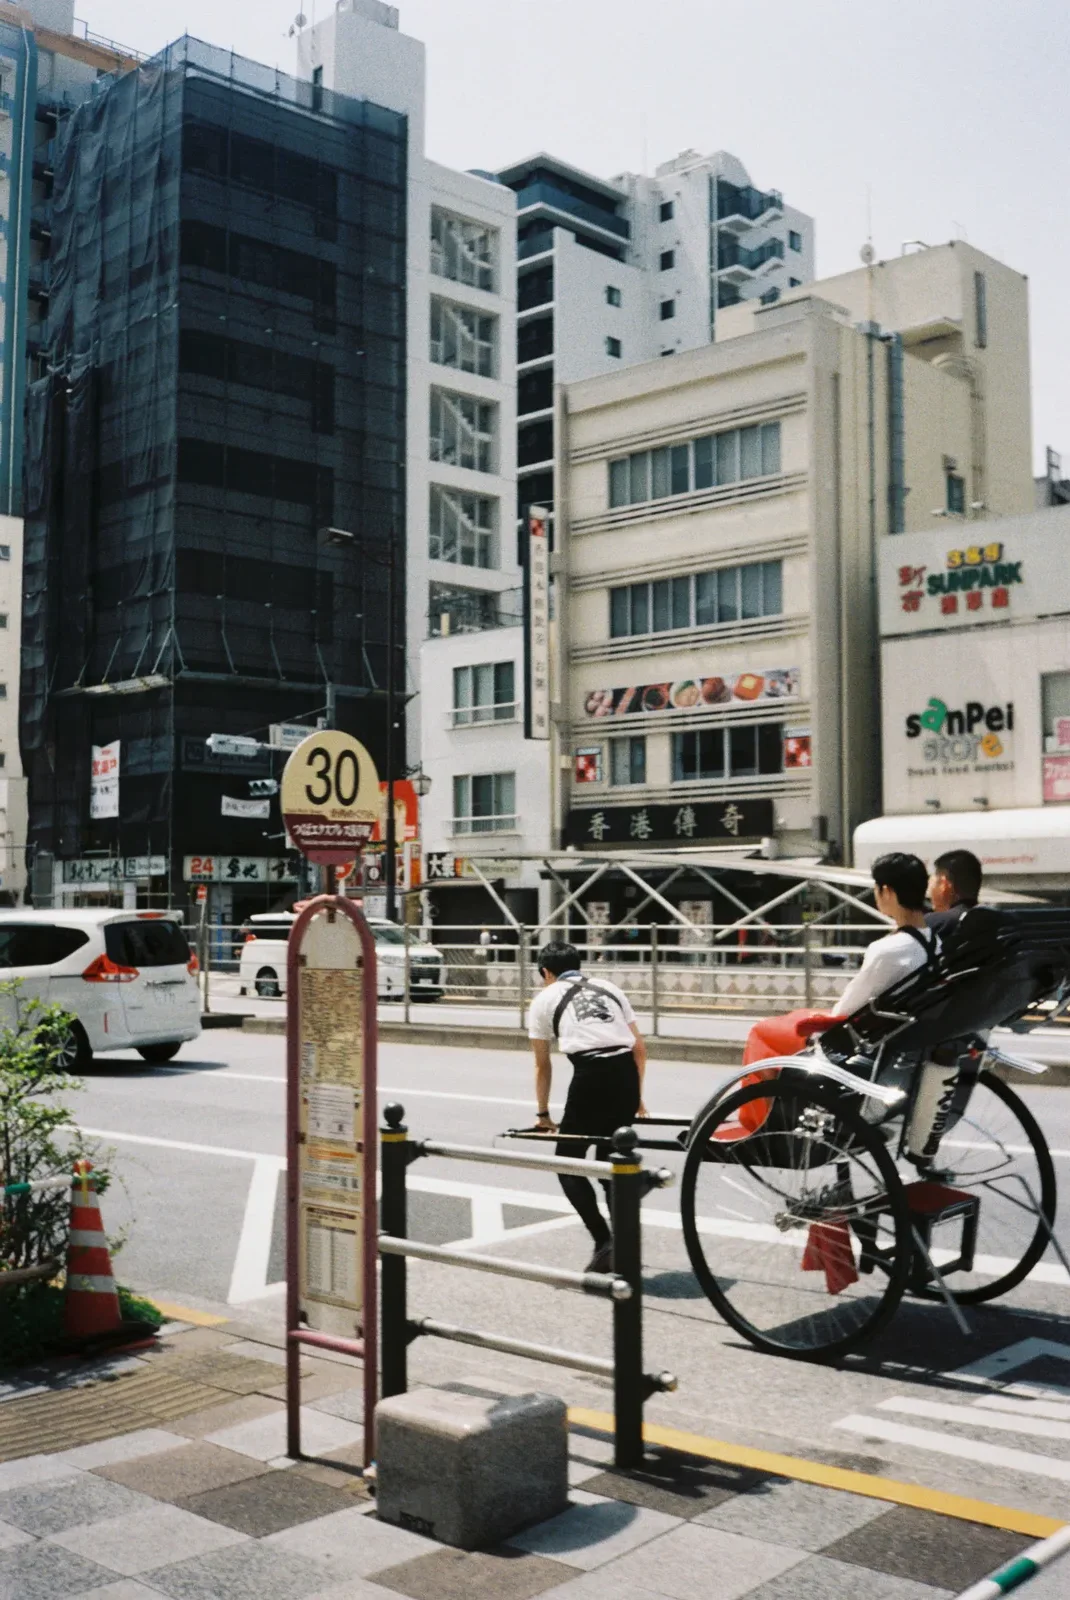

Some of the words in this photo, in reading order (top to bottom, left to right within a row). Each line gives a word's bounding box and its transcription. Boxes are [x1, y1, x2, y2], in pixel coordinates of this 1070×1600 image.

[927, 561, 1023, 596] SUNPARK
[305, 746, 359, 806] 30
[190, 856, 214, 874] 24
